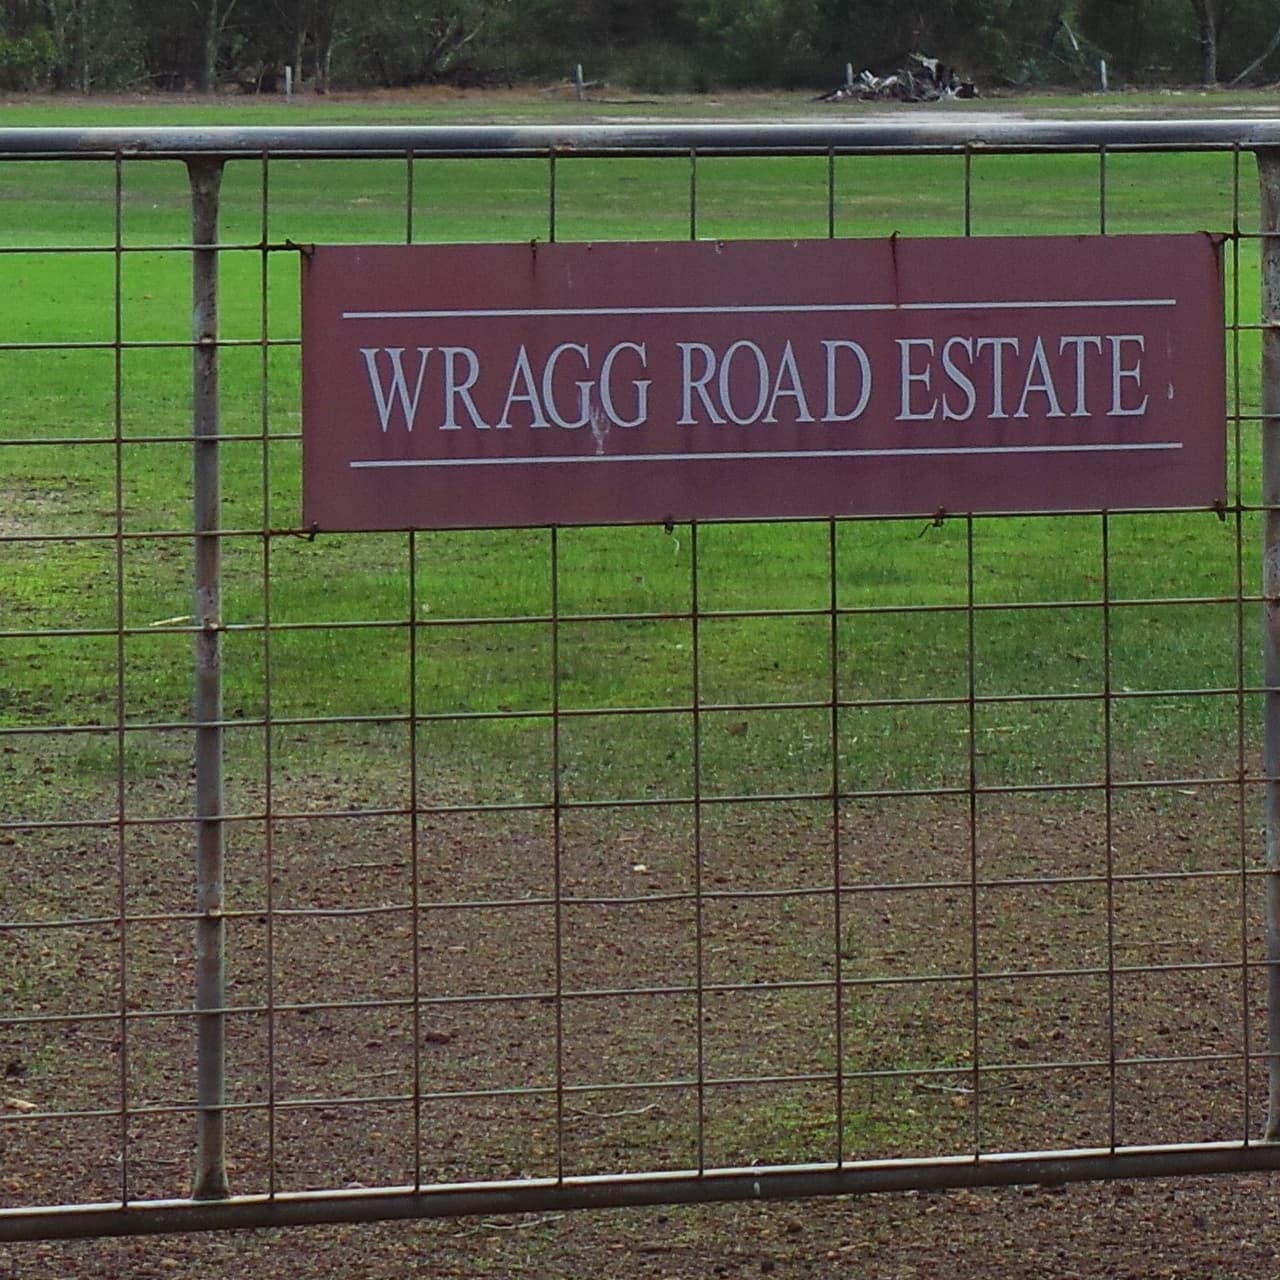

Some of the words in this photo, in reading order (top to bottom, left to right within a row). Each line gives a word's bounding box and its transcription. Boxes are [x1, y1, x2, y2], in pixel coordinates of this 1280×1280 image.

[360, 341, 652, 433] WRAGG
[676, 339, 873, 426] ROAD
[894, 334, 1149, 422] ESTATE
